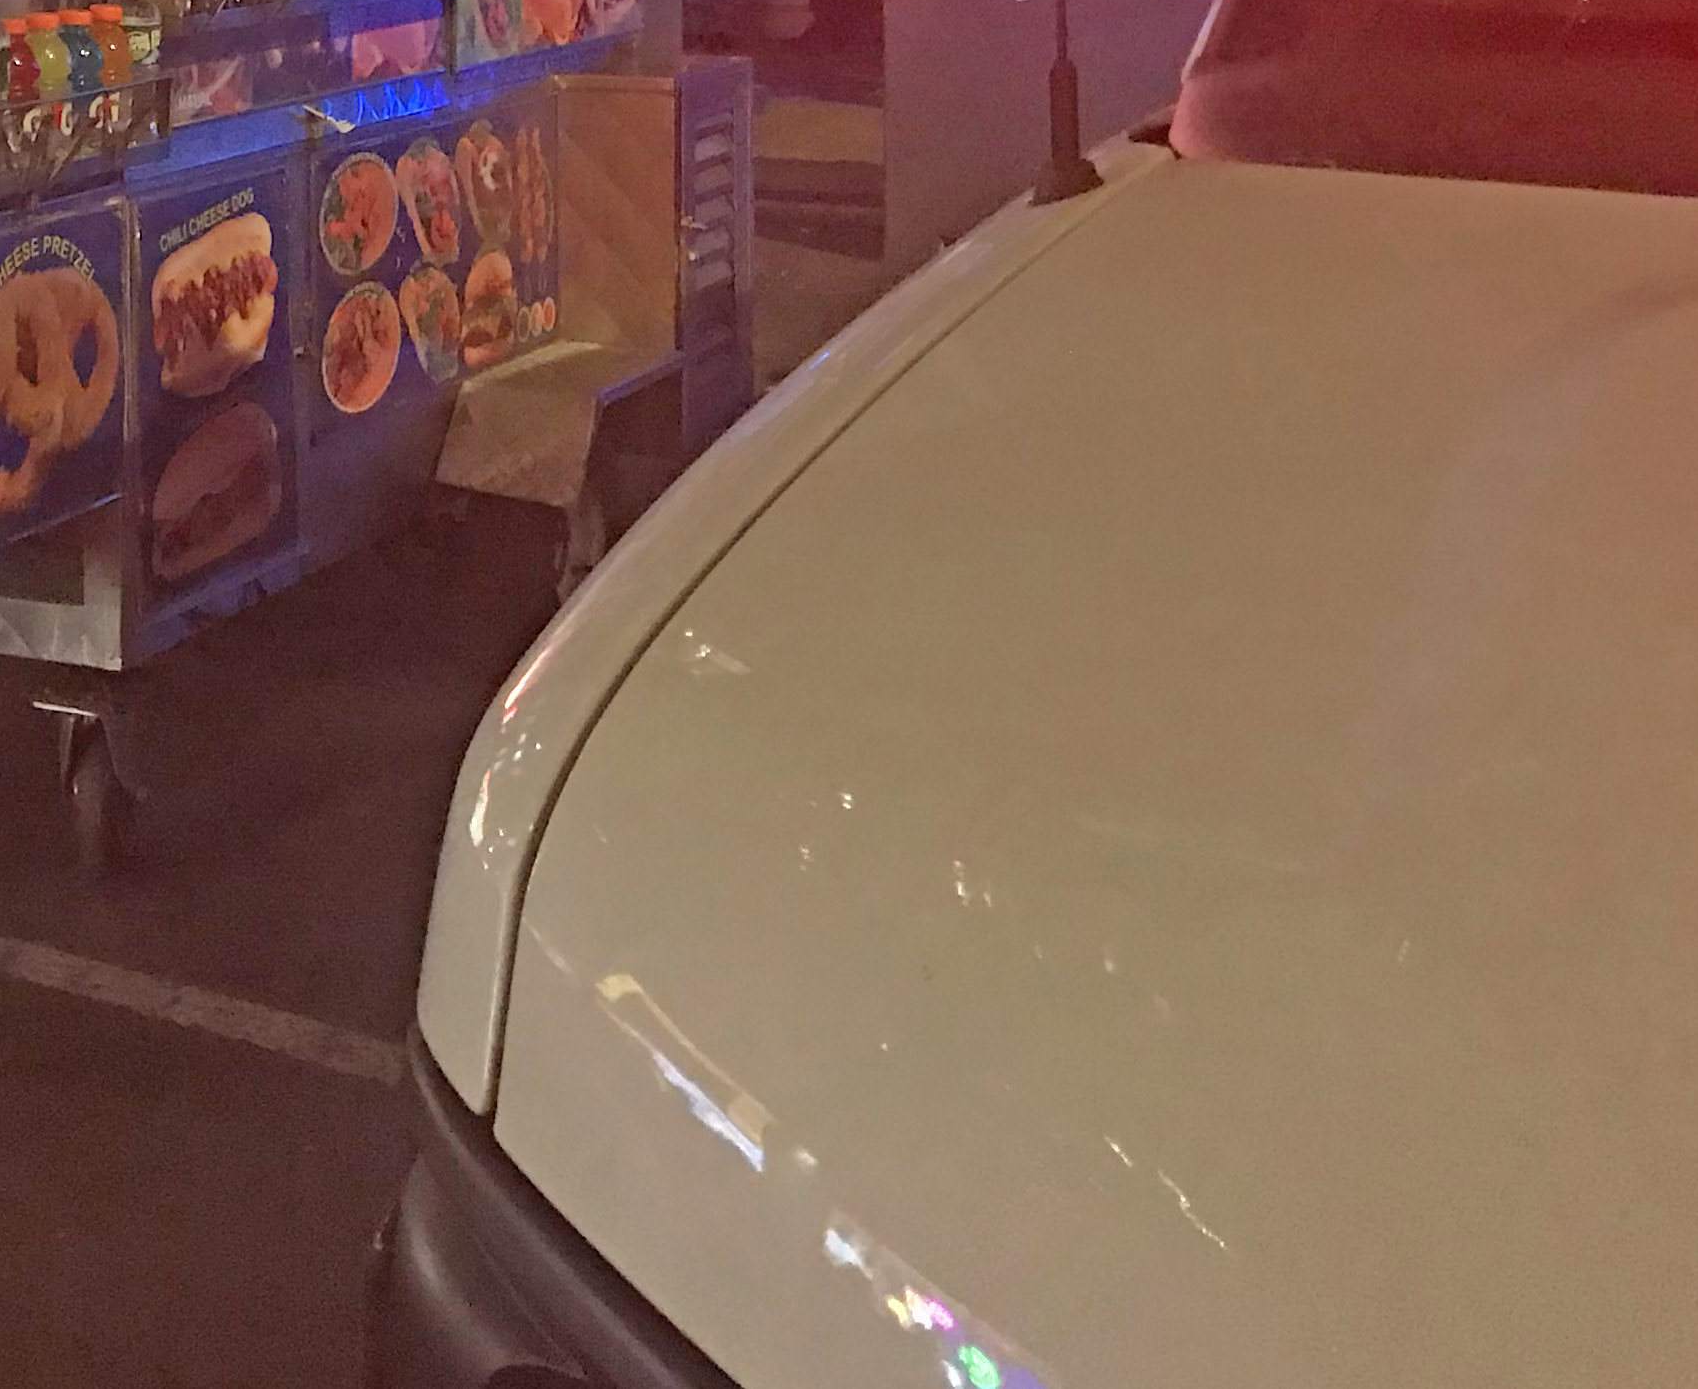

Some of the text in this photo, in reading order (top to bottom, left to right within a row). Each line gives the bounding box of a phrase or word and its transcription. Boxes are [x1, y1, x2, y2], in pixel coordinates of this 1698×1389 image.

[159, 187, 255, 252] CHILI CHEESE DOG
